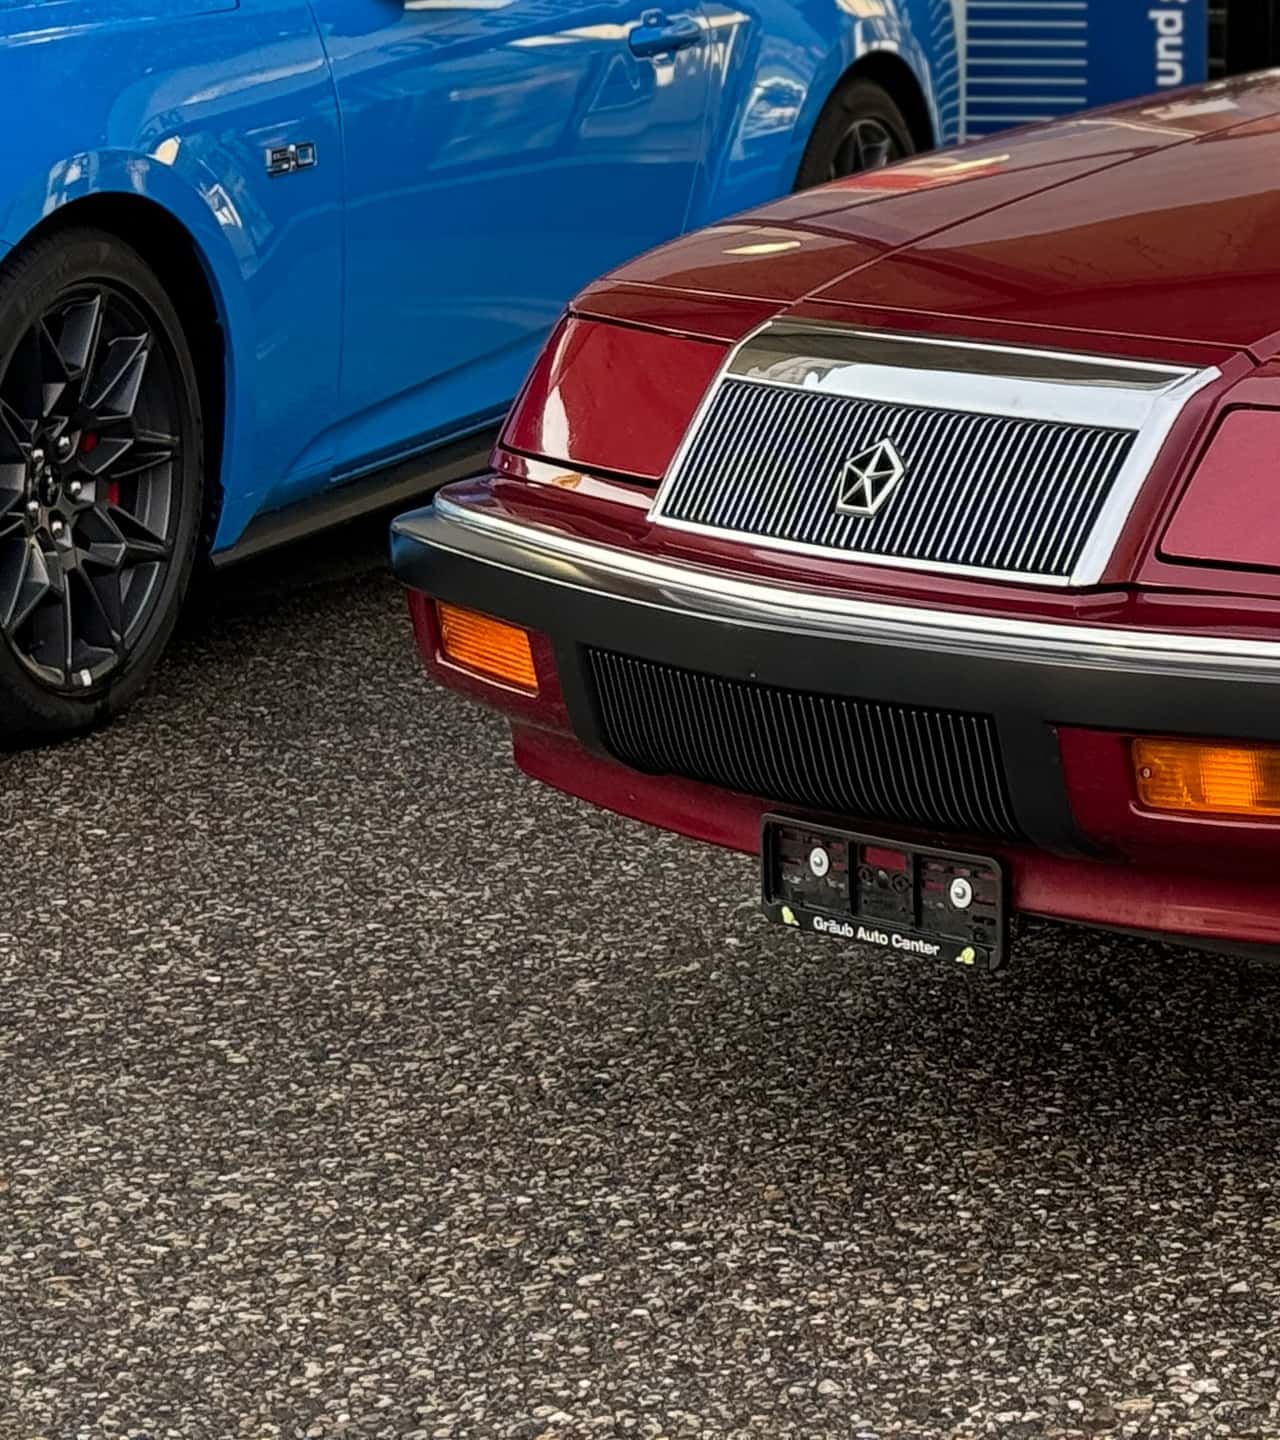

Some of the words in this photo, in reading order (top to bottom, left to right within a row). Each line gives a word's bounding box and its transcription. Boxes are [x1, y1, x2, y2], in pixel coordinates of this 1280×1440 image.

[1148, 10, 1184, 86] und
[813, 915, 855, 939] Gräub
[856, 926, 889, 947] Auto
[891, 933, 941, 957] Center
